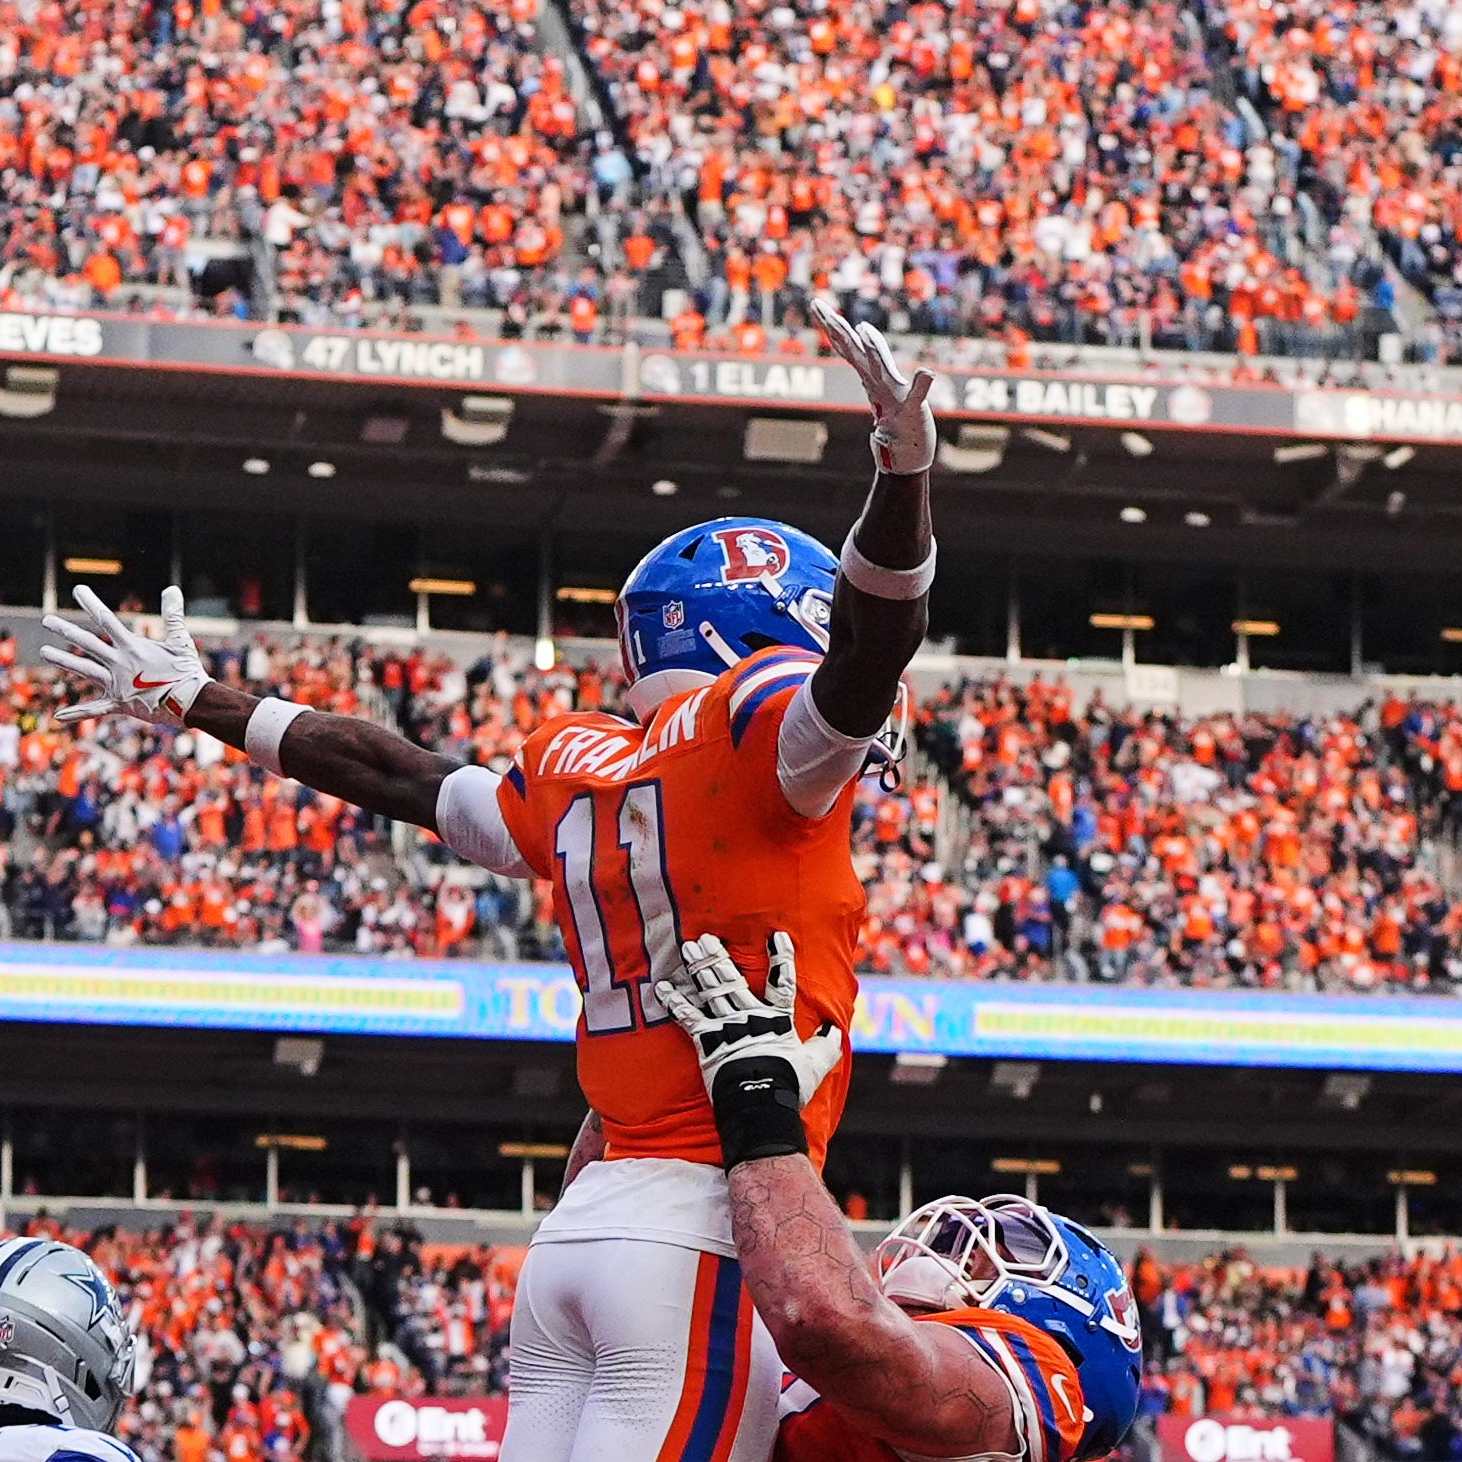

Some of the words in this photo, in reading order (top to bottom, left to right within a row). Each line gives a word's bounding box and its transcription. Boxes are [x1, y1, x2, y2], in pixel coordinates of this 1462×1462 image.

[303, 336, 350, 371] 47
[357, 339, 484, 380] LYNCH
[690, 361, 710, 392] 1
[716, 361, 825, 398] ELAM
[964, 377, 1009, 412] 24
[1016, 379, 1158, 419] BAILEY
[555, 778, 698, 1036] 11
